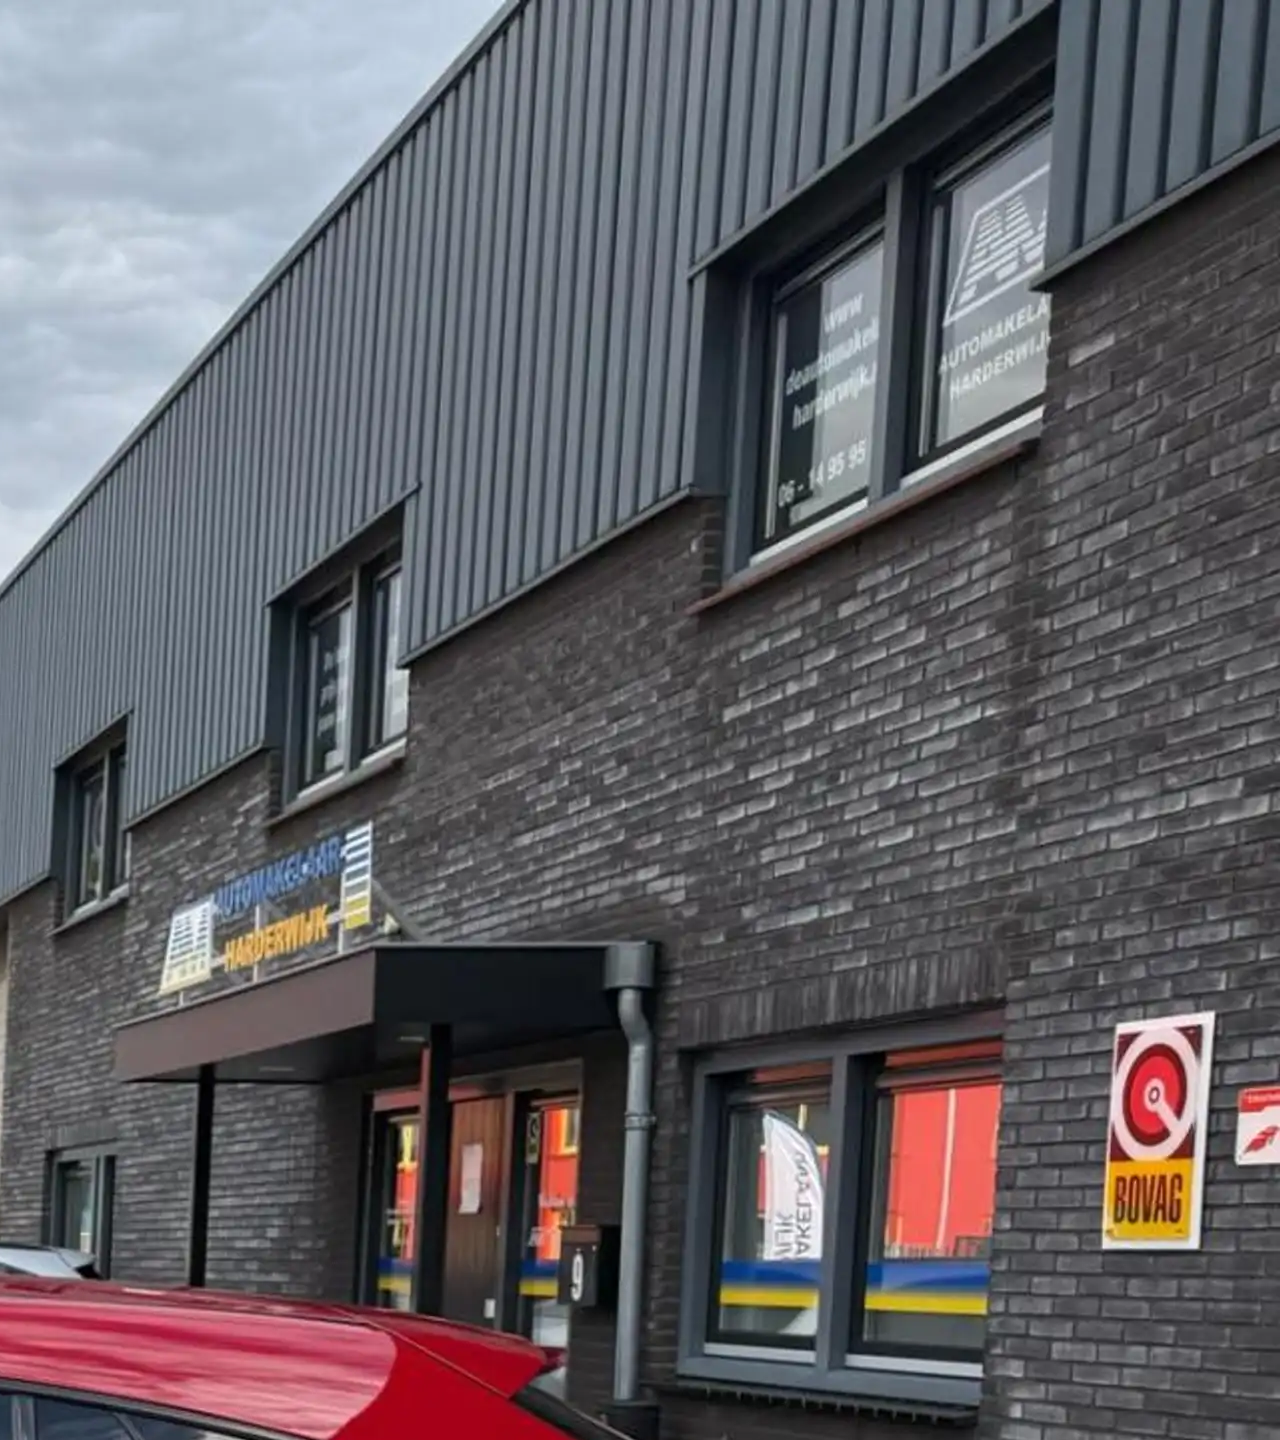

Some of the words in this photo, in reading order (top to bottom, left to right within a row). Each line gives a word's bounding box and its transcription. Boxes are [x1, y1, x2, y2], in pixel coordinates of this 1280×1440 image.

[224, 903, 328, 972] HARDERWIJK
[1113, 1173, 1183, 1224] BOVAG
[571, 1253, 584, 1301] 9
